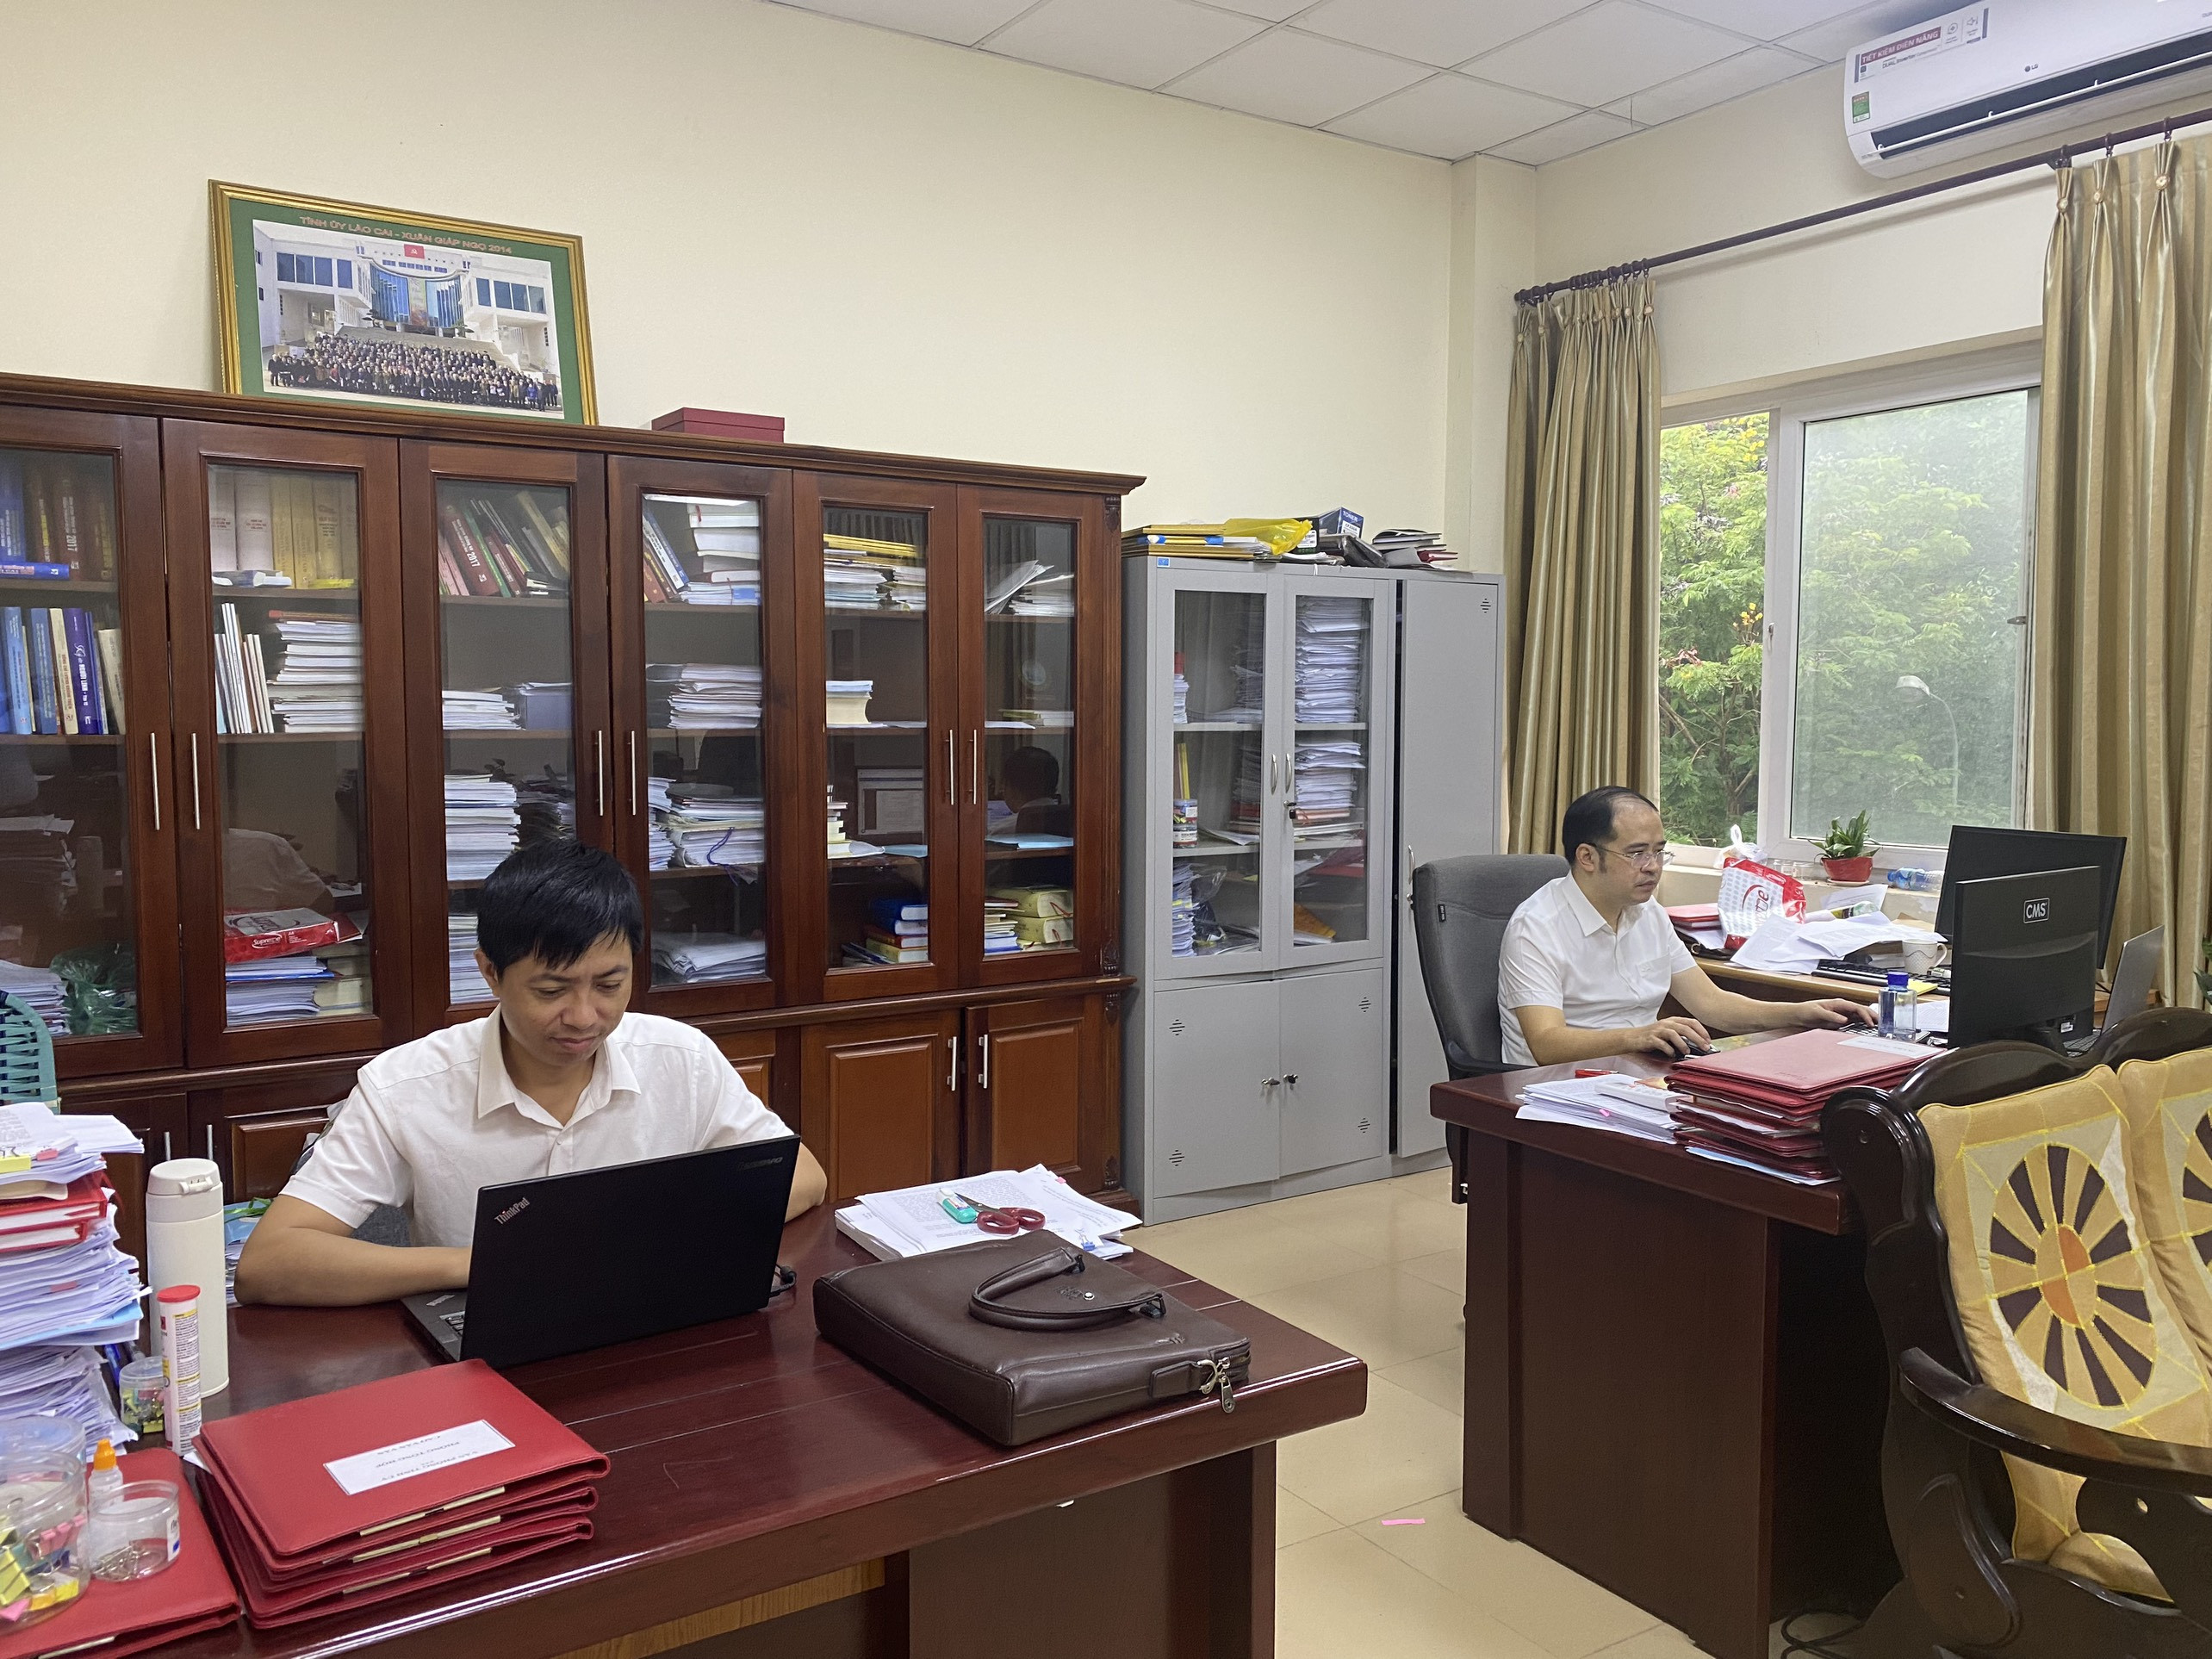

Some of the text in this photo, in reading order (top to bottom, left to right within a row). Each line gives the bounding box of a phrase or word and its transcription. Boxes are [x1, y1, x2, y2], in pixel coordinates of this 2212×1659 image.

[488, 244, 513, 254] 2014
[467, 551, 481, 567] 2017
[2026, 902, 2047, 919] CMS
[494, 1196, 531, 1224] ThinkPad
